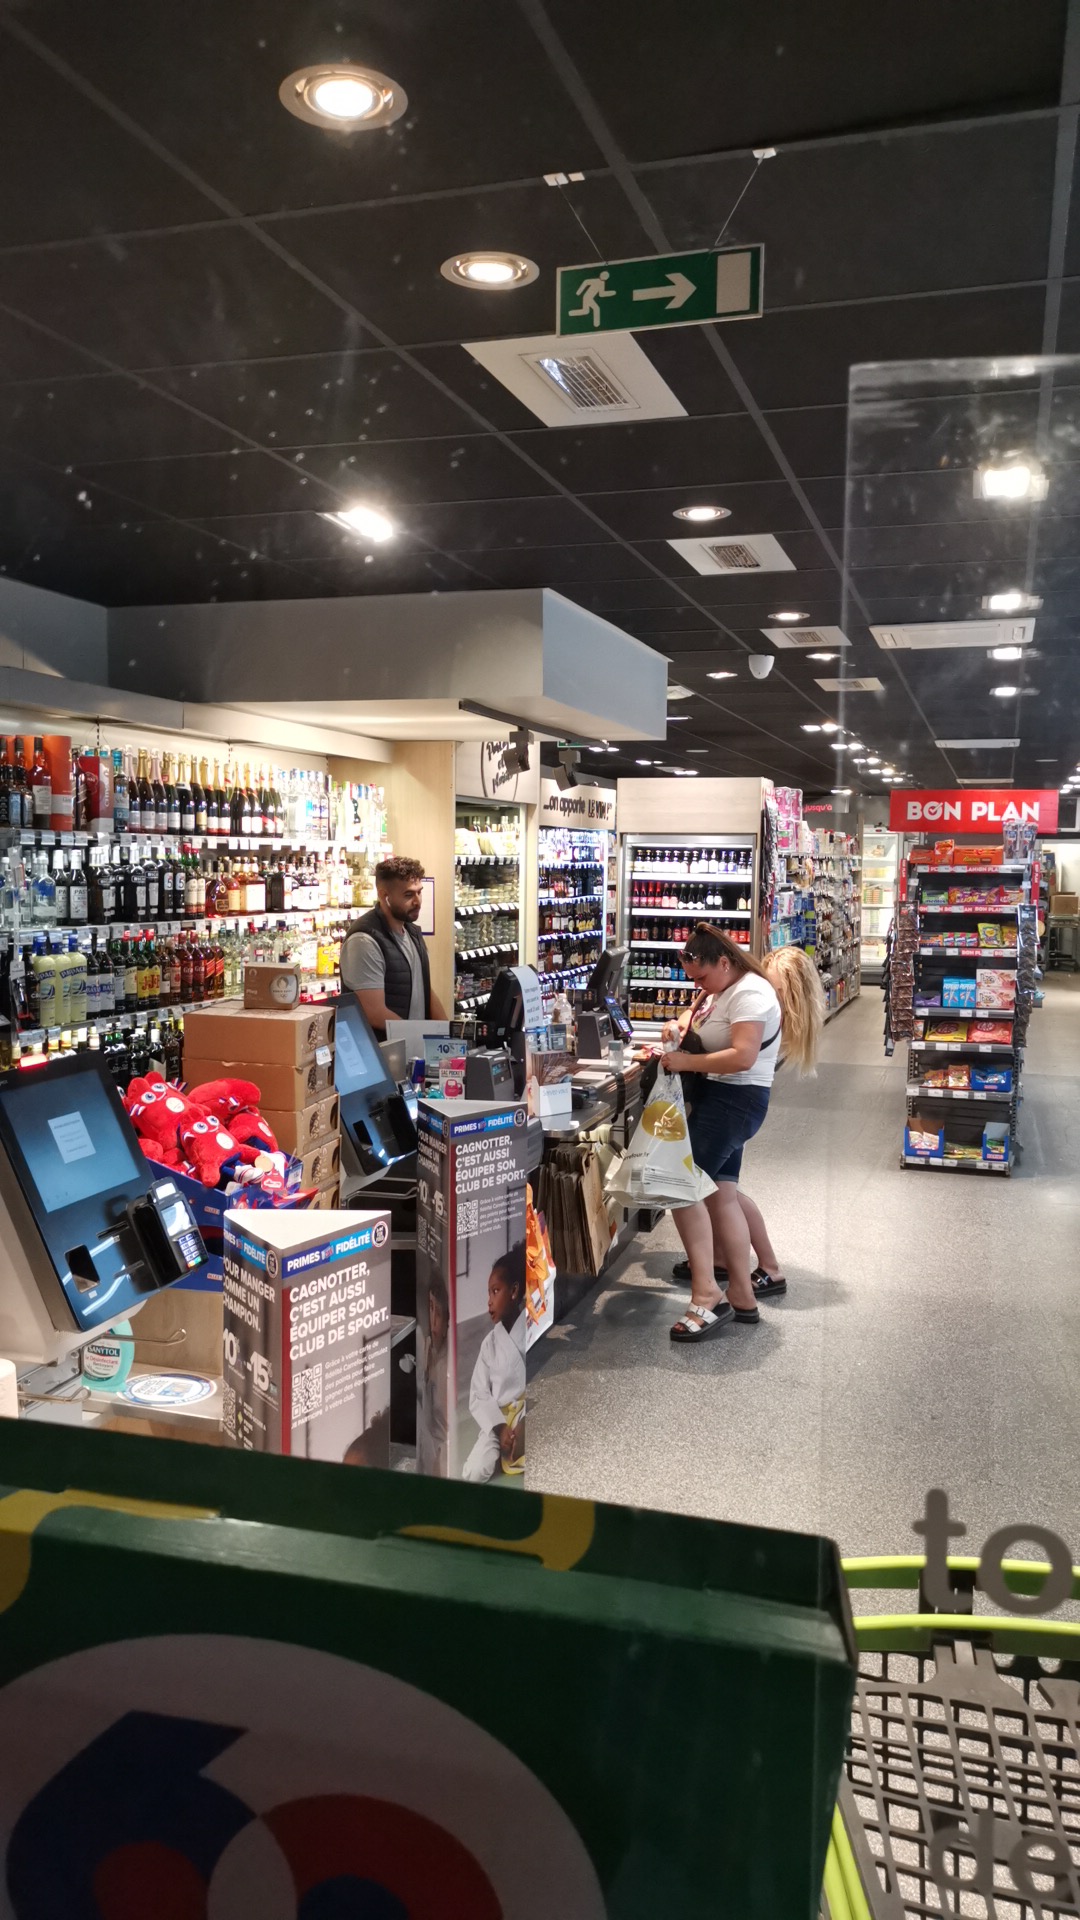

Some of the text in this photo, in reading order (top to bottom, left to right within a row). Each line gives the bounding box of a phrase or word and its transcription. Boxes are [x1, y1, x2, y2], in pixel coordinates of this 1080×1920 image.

[907, 801, 1040, 822] BON PLAN
[454, 1114, 513, 1134] PRIMES FIDÉLITÉ
[429, 1135, 447, 1155] MANGER
[455, 1135, 513, 1156] CAGNOTTER,
[455, 1148, 510, 1168] C'EST AUSSI
[455, 1159, 516, 1181] ÉQUIPER SON
[455, 1169, 526, 1194] CLUB DE SPORT.
[243, 1242, 266, 1264] FIDÉLITÉ
[287, 1251, 321, 1272] PRIMES
[335, 1230, 371, 1255] FIDÉLITÉ
[240, 1267, 275, 1304] MANGER
[289, 1261, 370, 1303] CAGNOTTER,
[247, 1291, 260, 1313] UN
[289, 1279, 366, 1322] C'EST AUSSI
[289, 1294, 375, 1343] ÉQUIPER SON
[289, 1306, 390, 1361] CLUB DE SPORT.
[88, 1346, 119, 1356] SANYTOL
[325, 1357, 341, 1370] Grâce
[345, 1349, 359, 1360] votre
[358, 1344, 372, 1354] carte
[372, 1341, 379, 1349] de
[325, 1367, 343, 1380] fidélité
[368, 1347, 388, 1361] cumulez
[325, 1362, 376, 1391] des points pour faire
[325, 1367, 385, 1403] gagner des équipements
[329, 1399, 343, 1410] votre
[912, 1488, 1074, 1616] to
[929, 1808, 1073, 1896] de
